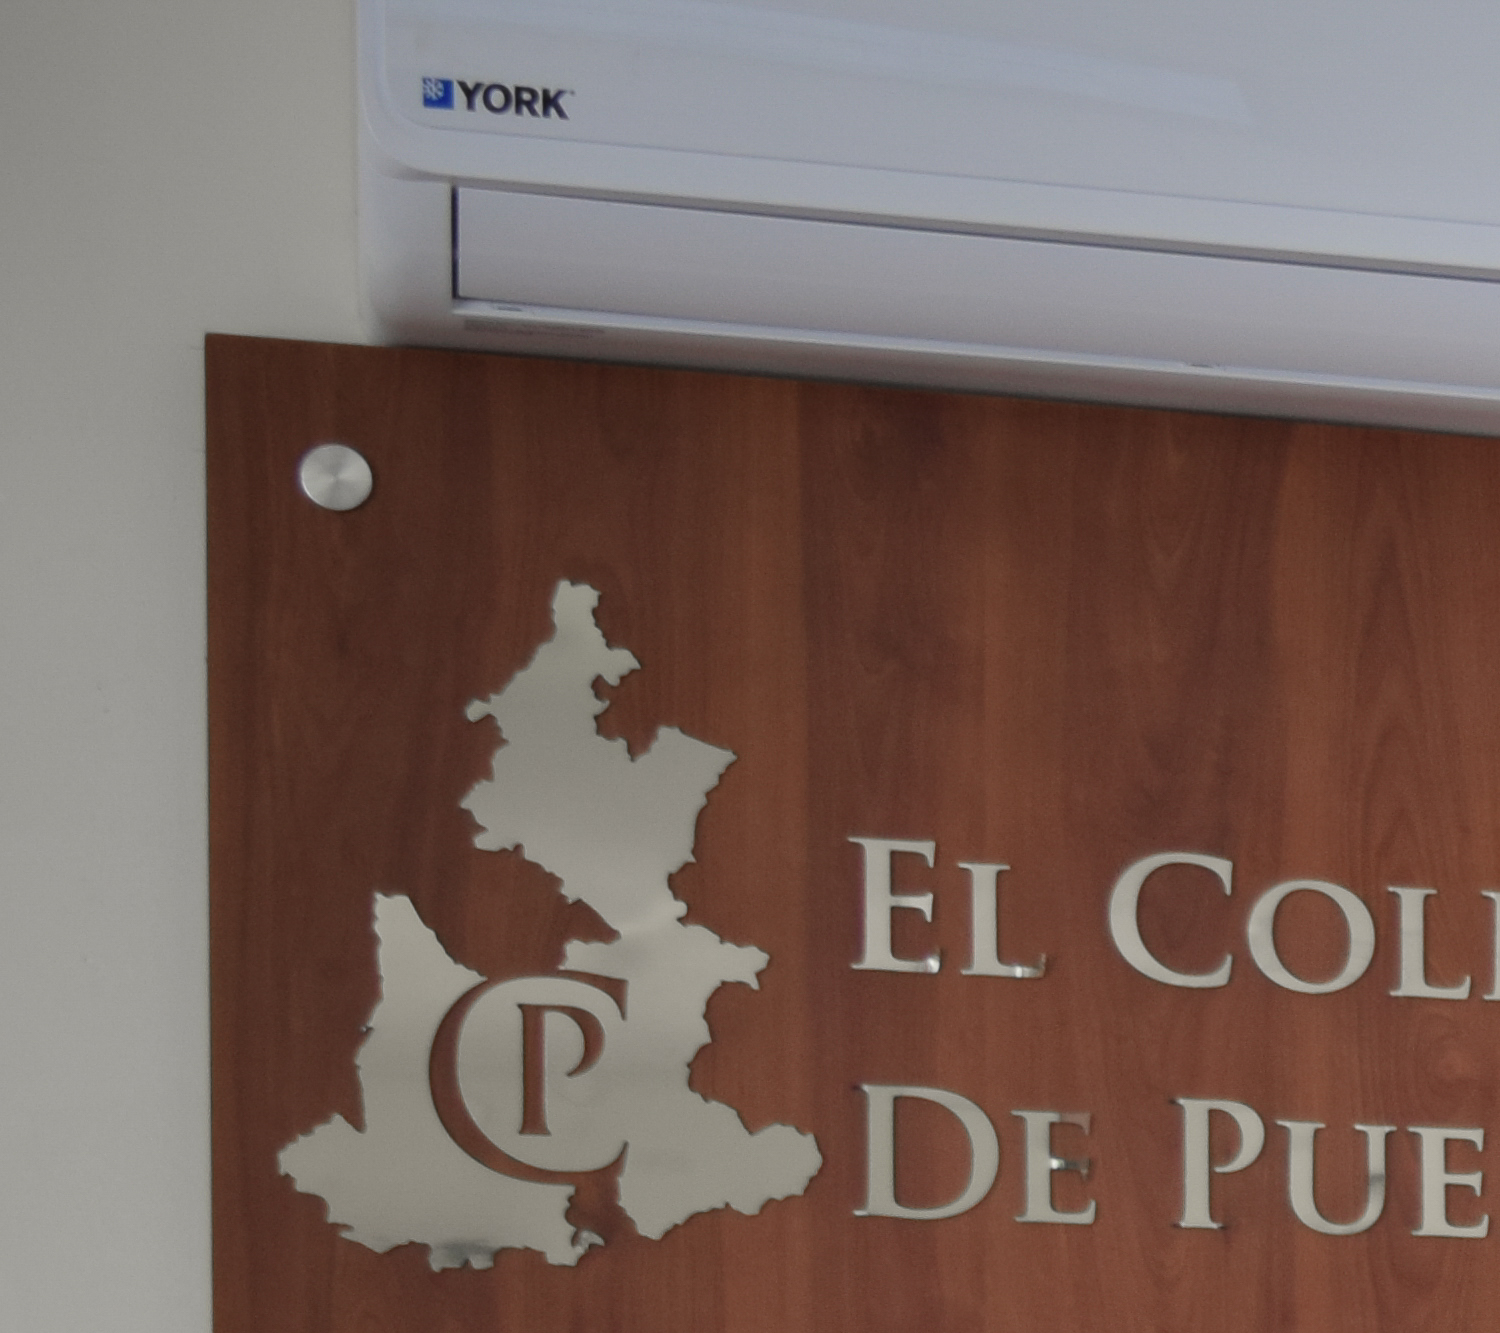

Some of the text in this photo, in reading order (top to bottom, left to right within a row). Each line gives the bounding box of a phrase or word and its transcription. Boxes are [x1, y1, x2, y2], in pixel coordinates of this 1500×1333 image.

[455, 80, 571, 120] YORK
[848, 835, 1046, 982] EL
[851, 1083, 1101, 1228] DE
